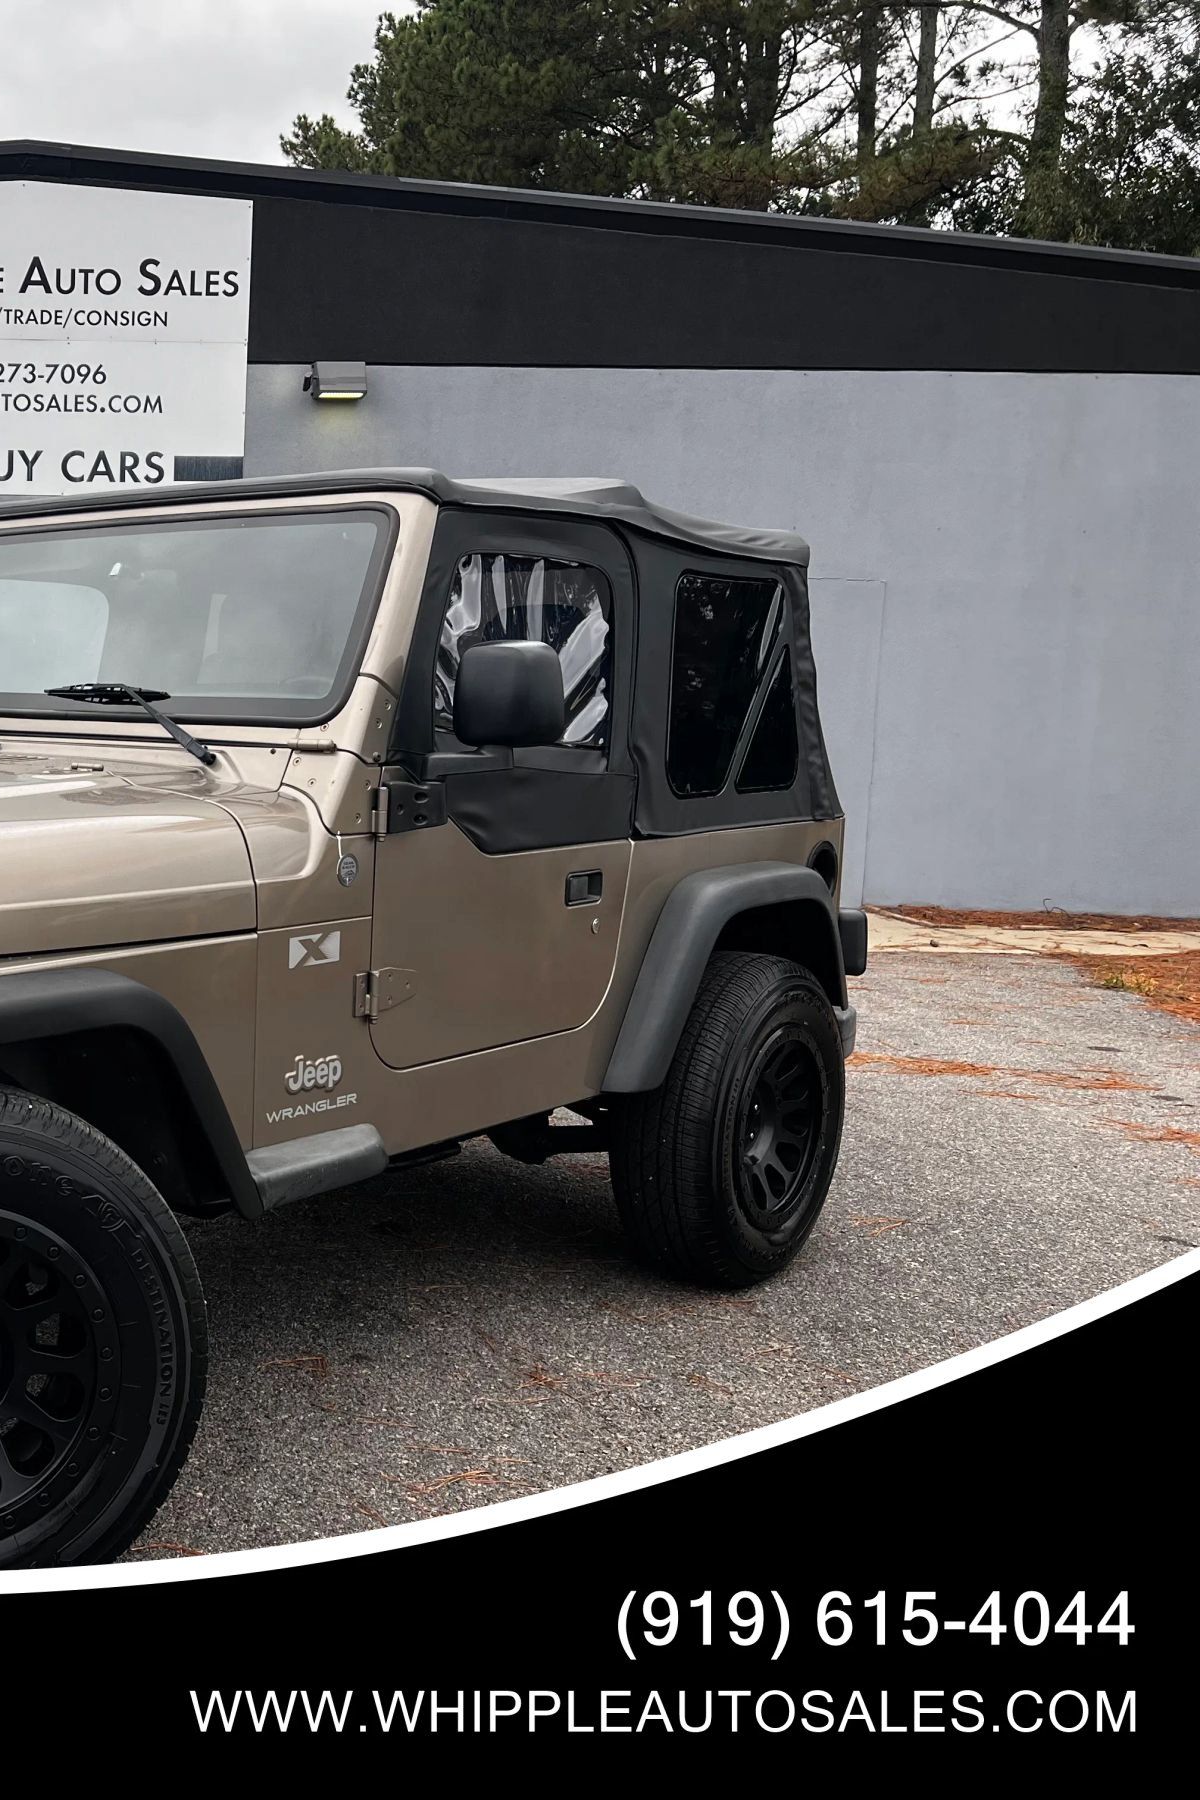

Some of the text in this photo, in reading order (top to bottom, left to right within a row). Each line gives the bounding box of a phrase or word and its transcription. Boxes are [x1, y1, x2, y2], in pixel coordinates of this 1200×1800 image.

[18, 256, 122, 296] AUTO
[137, 258, 240, 297] SALES
[61, 450, 165, 484] CARS
[284, 1055, 343, 1094] Jeep
[266, 1093, 358, 1123] WRANGLER
